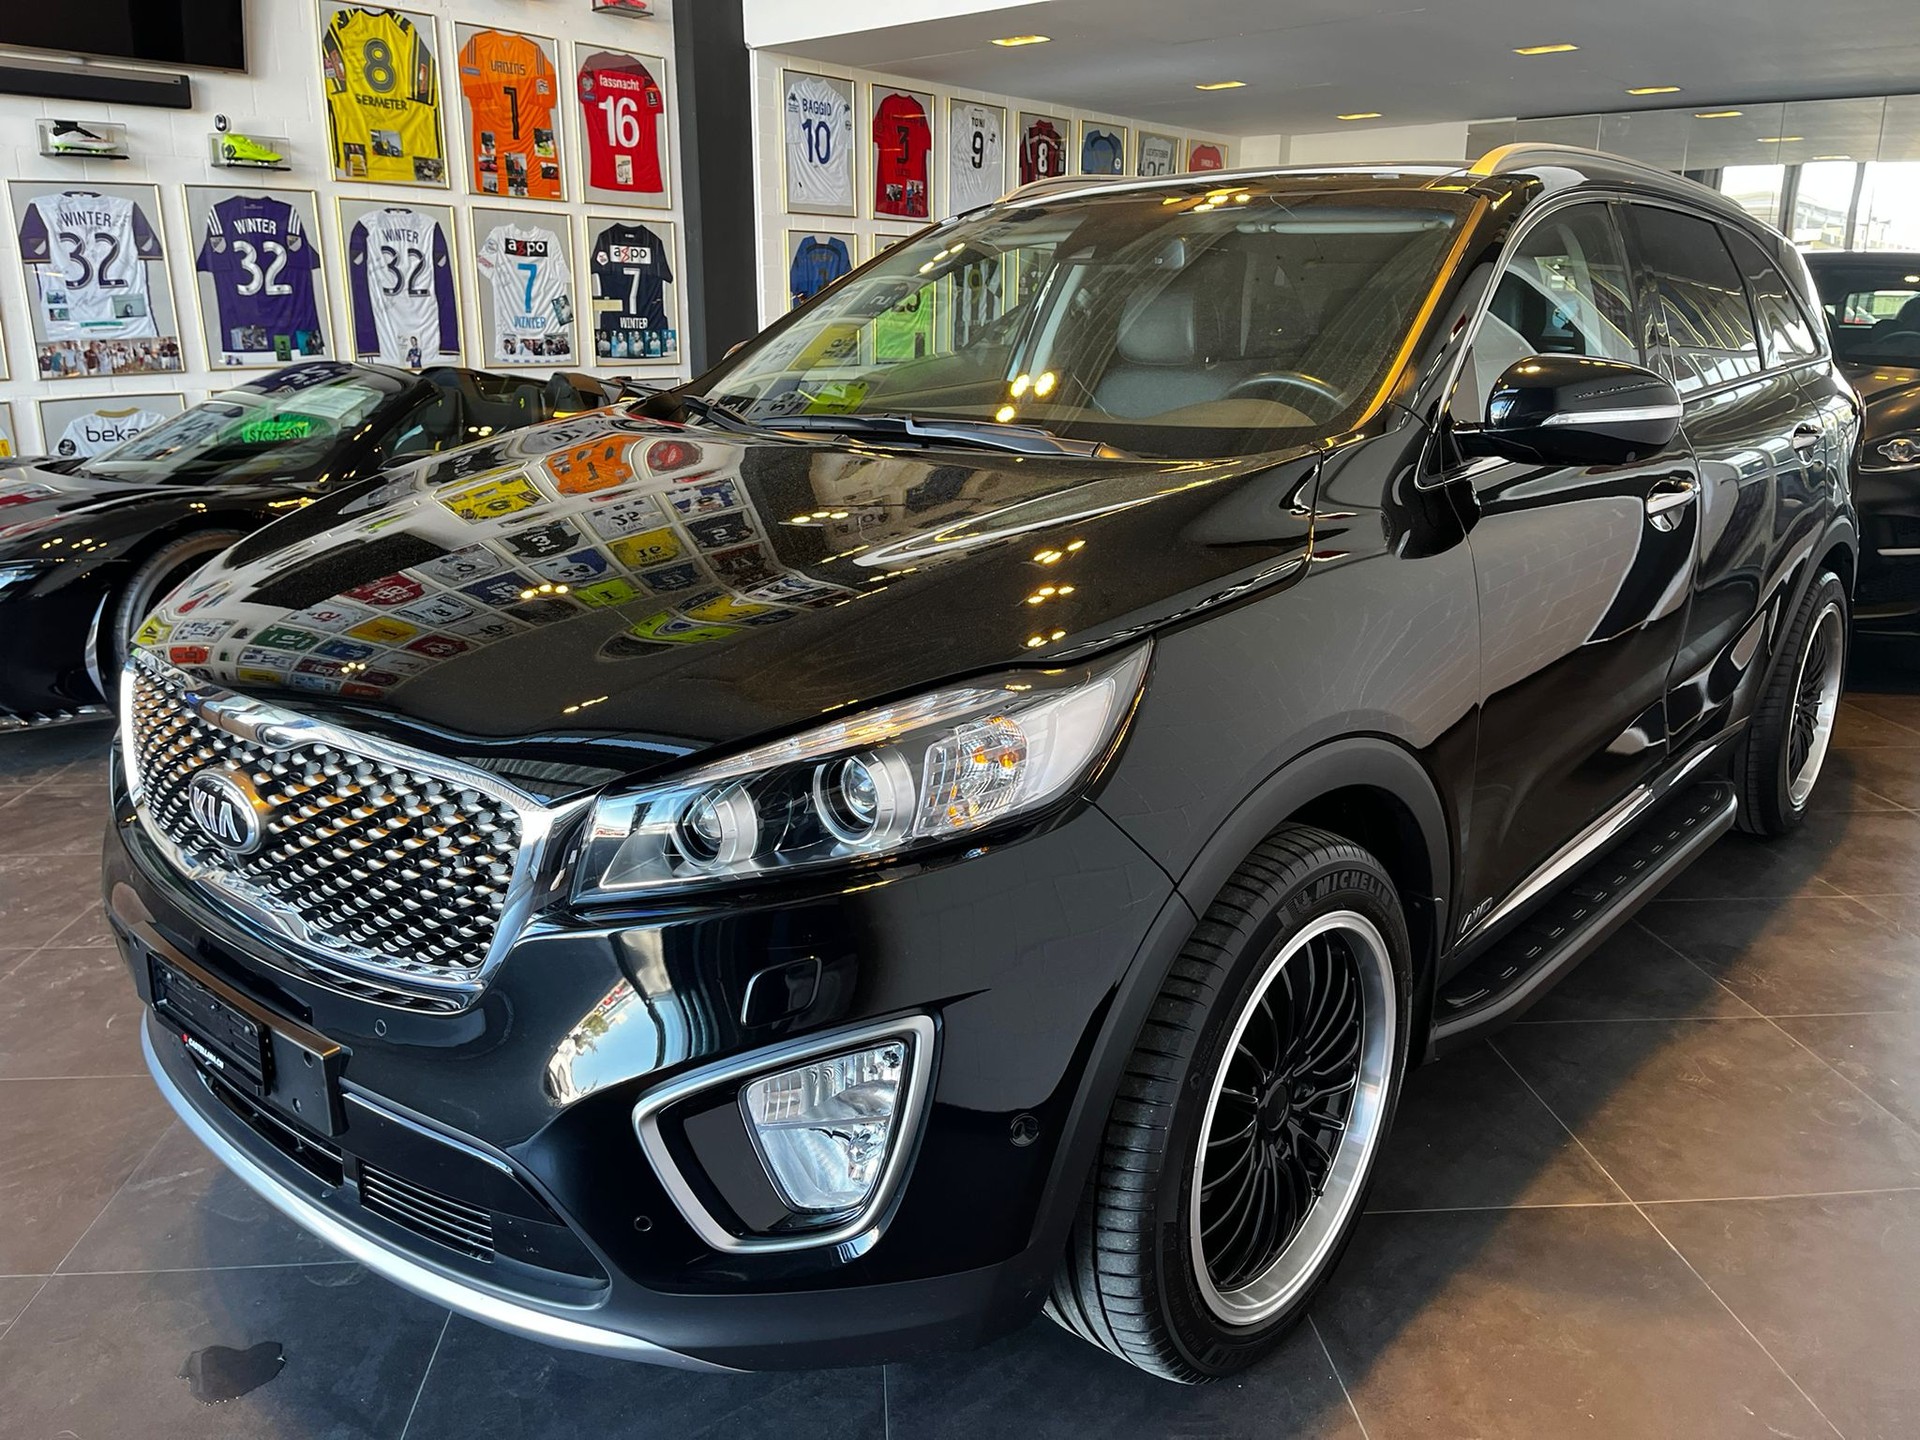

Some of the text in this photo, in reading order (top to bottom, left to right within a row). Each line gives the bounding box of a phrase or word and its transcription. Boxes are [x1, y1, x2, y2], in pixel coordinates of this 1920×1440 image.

[363, 37, 396, 93] 8
[503, 86, 520, 140] 1
[598, 95, 640, 148] 16
[802, 98, 832, 116] BAGGIO
[801, 118, 831, 164] 10
[896, 125, 909, 164] 3
[971, 131, 984, 169] 9
[1037, 141, 1049, 174] 8
[60, 210, 111, 228] WINTER
[234, 218, 277, 235] WINTER
[382, 229, 419, 244] WINTER
[59, 232, 129, 290] 32
[232, 240, 293, 296] 32
[380, 245, 431, 298] 32
[517, 263, 537, 313] 7
[623, 267, 640, 315] 7
[514, 316, 547, 330] WINTER
[619, 316, 648, 329] WINTER
[194, 786, 242, 842] KIA
[1315, 870, 1392, 907] MICHELIN
